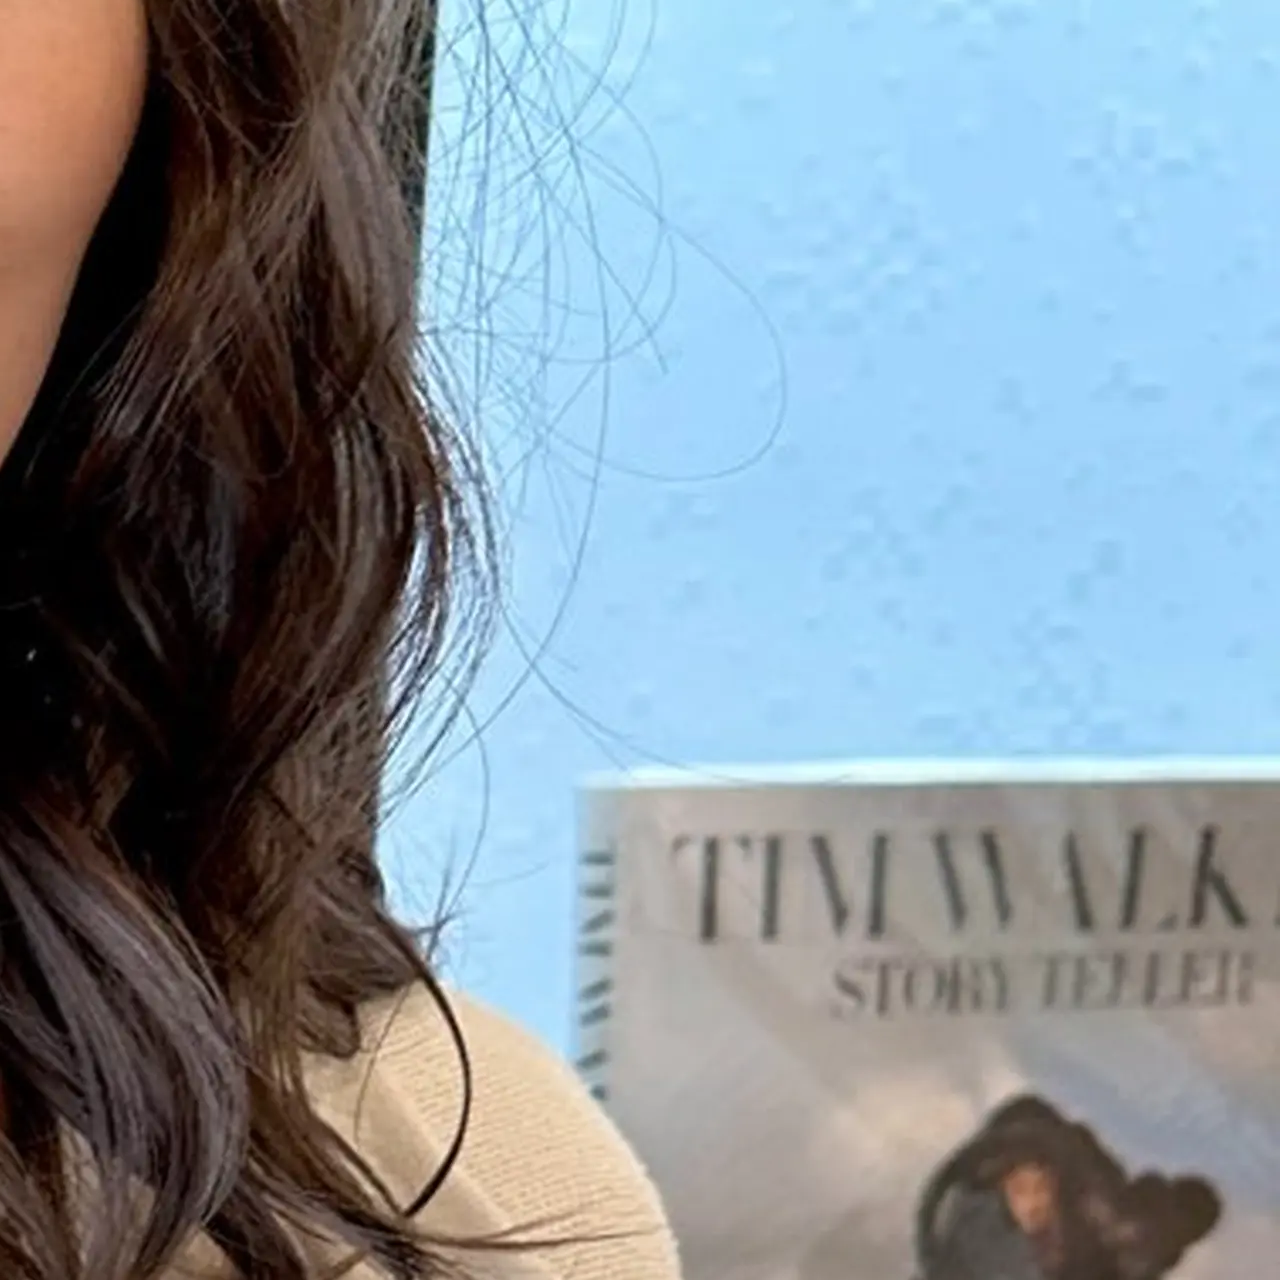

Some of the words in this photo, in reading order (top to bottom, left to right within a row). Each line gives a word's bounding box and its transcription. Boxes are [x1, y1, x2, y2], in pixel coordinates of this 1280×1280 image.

[671, 832, 890, 942] TIM
[934, 824, 1280, 934] WALK
[832, 956, 1010, 1017] STORY
[1042, 950, 1256, 1009] TELLER
